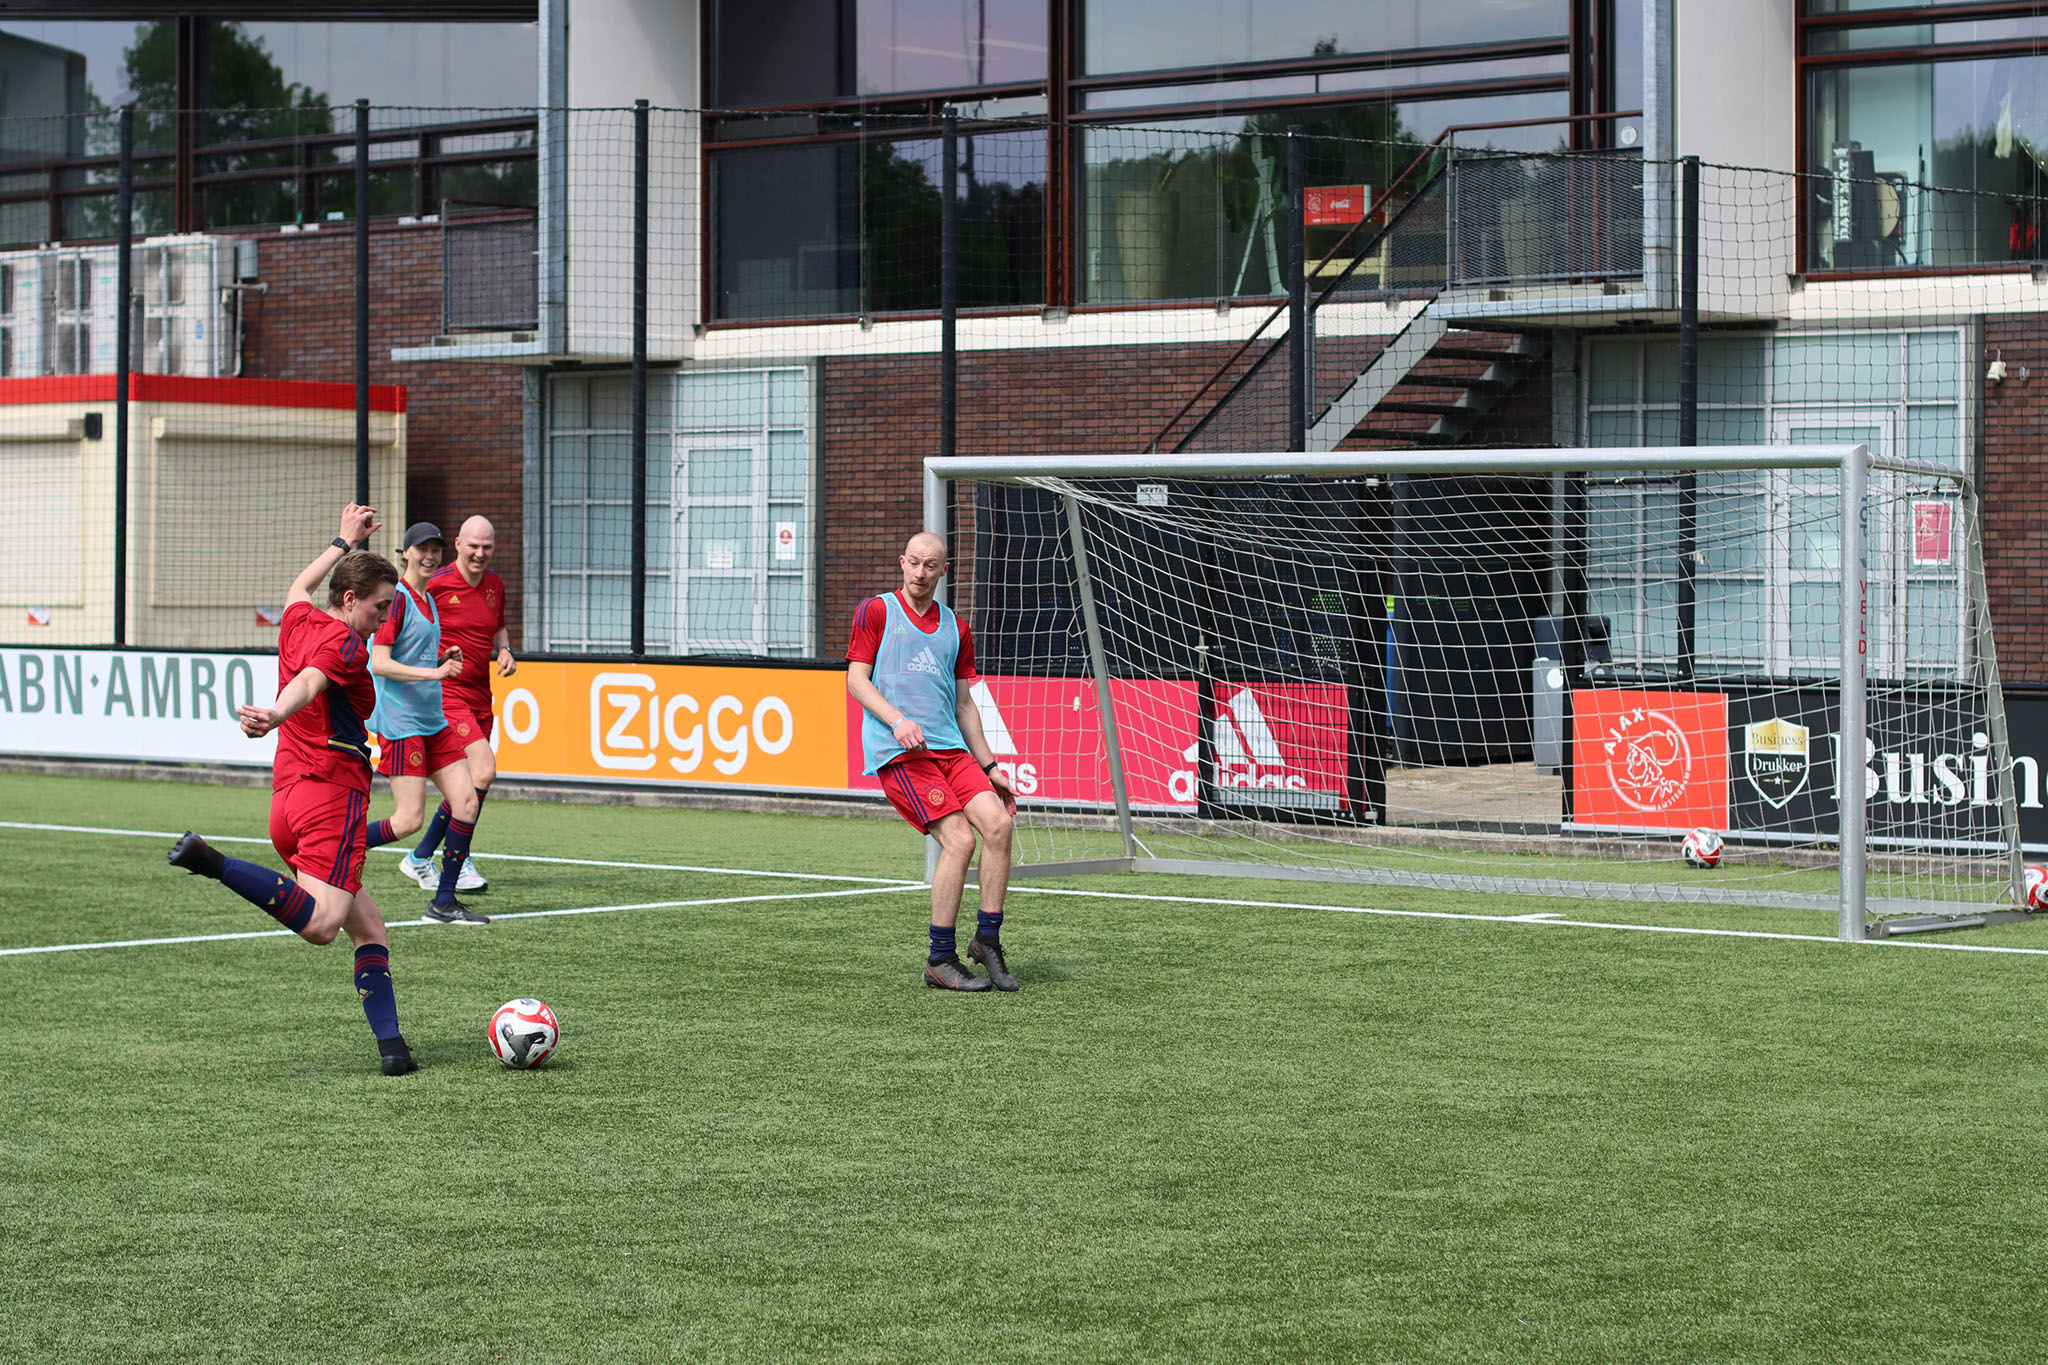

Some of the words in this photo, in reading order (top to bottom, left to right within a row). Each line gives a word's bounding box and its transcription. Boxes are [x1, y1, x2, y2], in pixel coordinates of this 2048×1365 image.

[1839, 159, 1850, 193] MAT
[1839, 196, 1850, 240] DART
[1858, 580, 1867, 655] VELD
[104, 656, 254, 722] AMRO
[907, 661, 941, 677] adidas
[1604, 707, 1645, 756] AJAX
[1751, 732, 1805, 747] Business
[1752, 757, 1804, 774] Drukker
[1829, 731, 2048, 809] Busin
